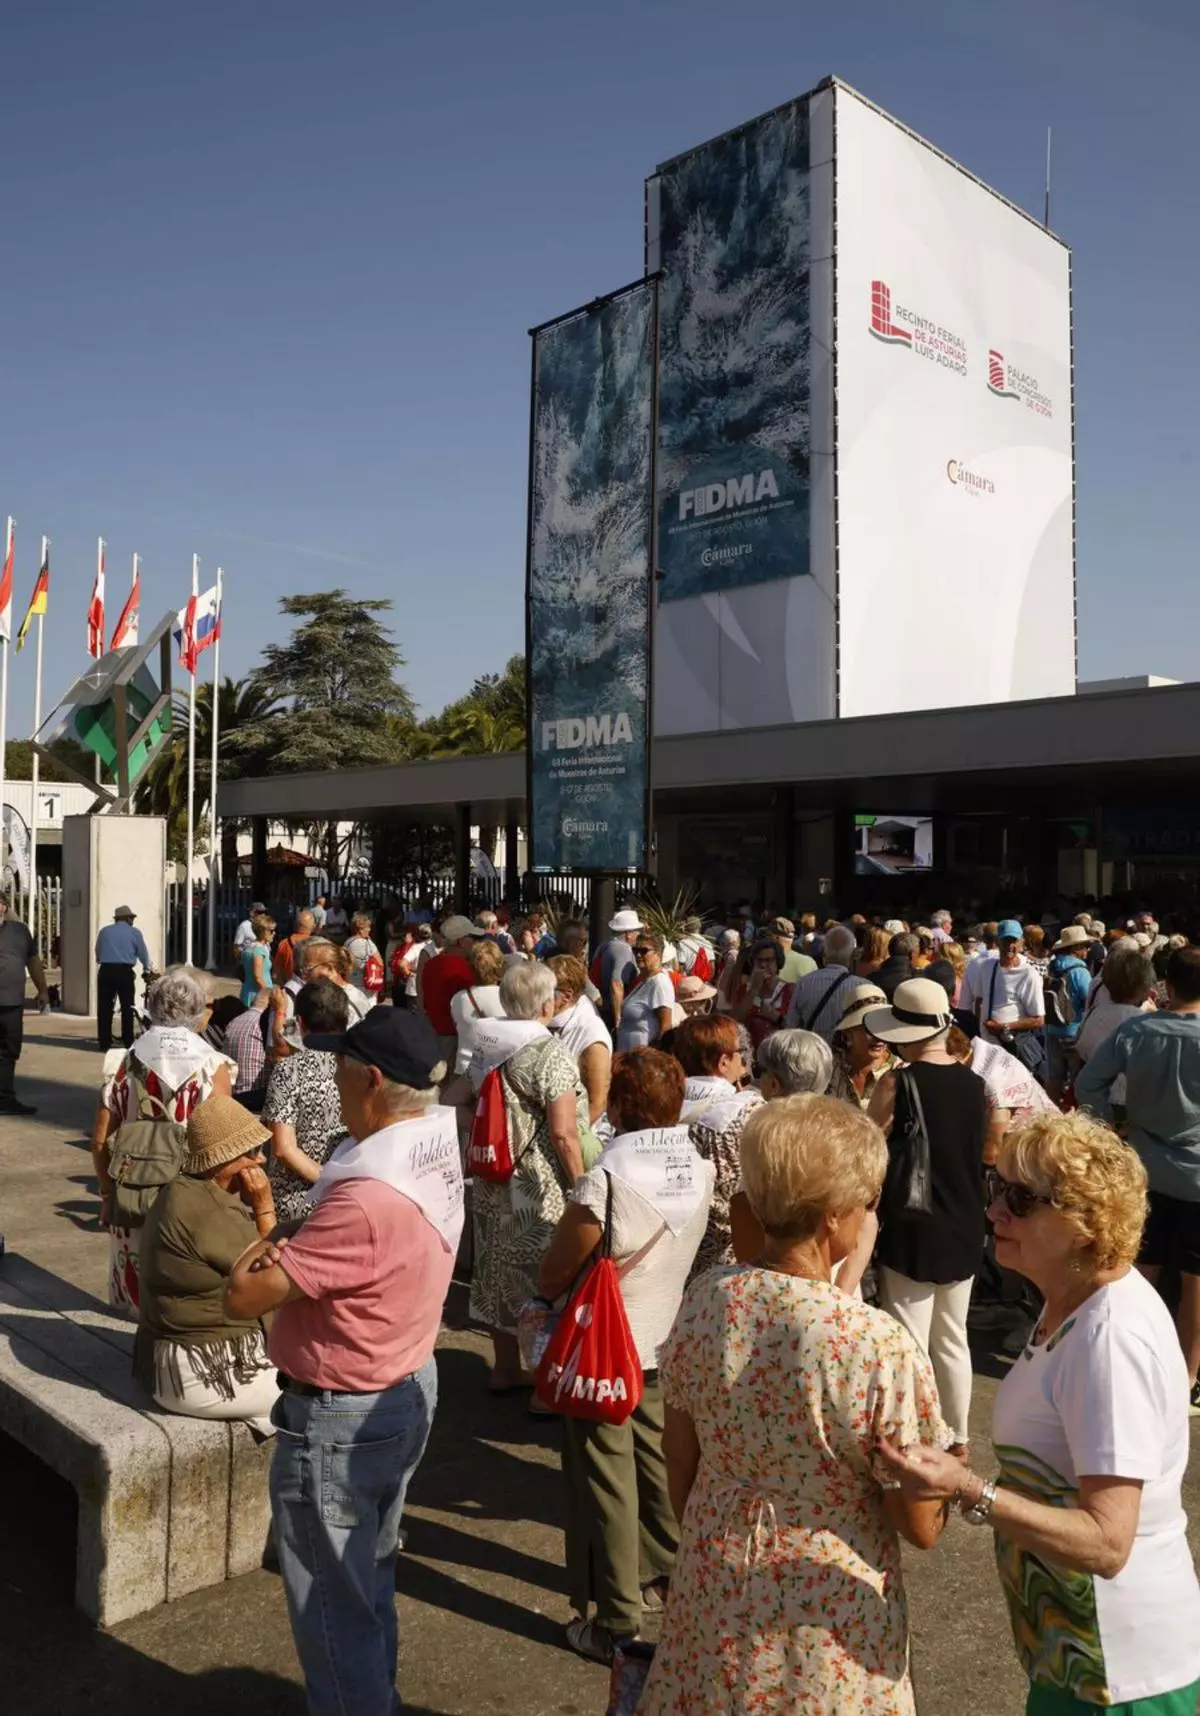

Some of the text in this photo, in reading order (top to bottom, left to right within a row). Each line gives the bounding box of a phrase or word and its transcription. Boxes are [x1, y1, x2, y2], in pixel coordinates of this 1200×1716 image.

[896, 305, 967, 351] RECINTO FERIAL
[914, 329, 967, 364] DE ASTURIAS
[914, 342, 968, 377] LUIS ADARO
[678, 469, 780, 521] FIDMA
[541, 712, 634, 750] FIDMA
[44, 798, 54, 818] 1
